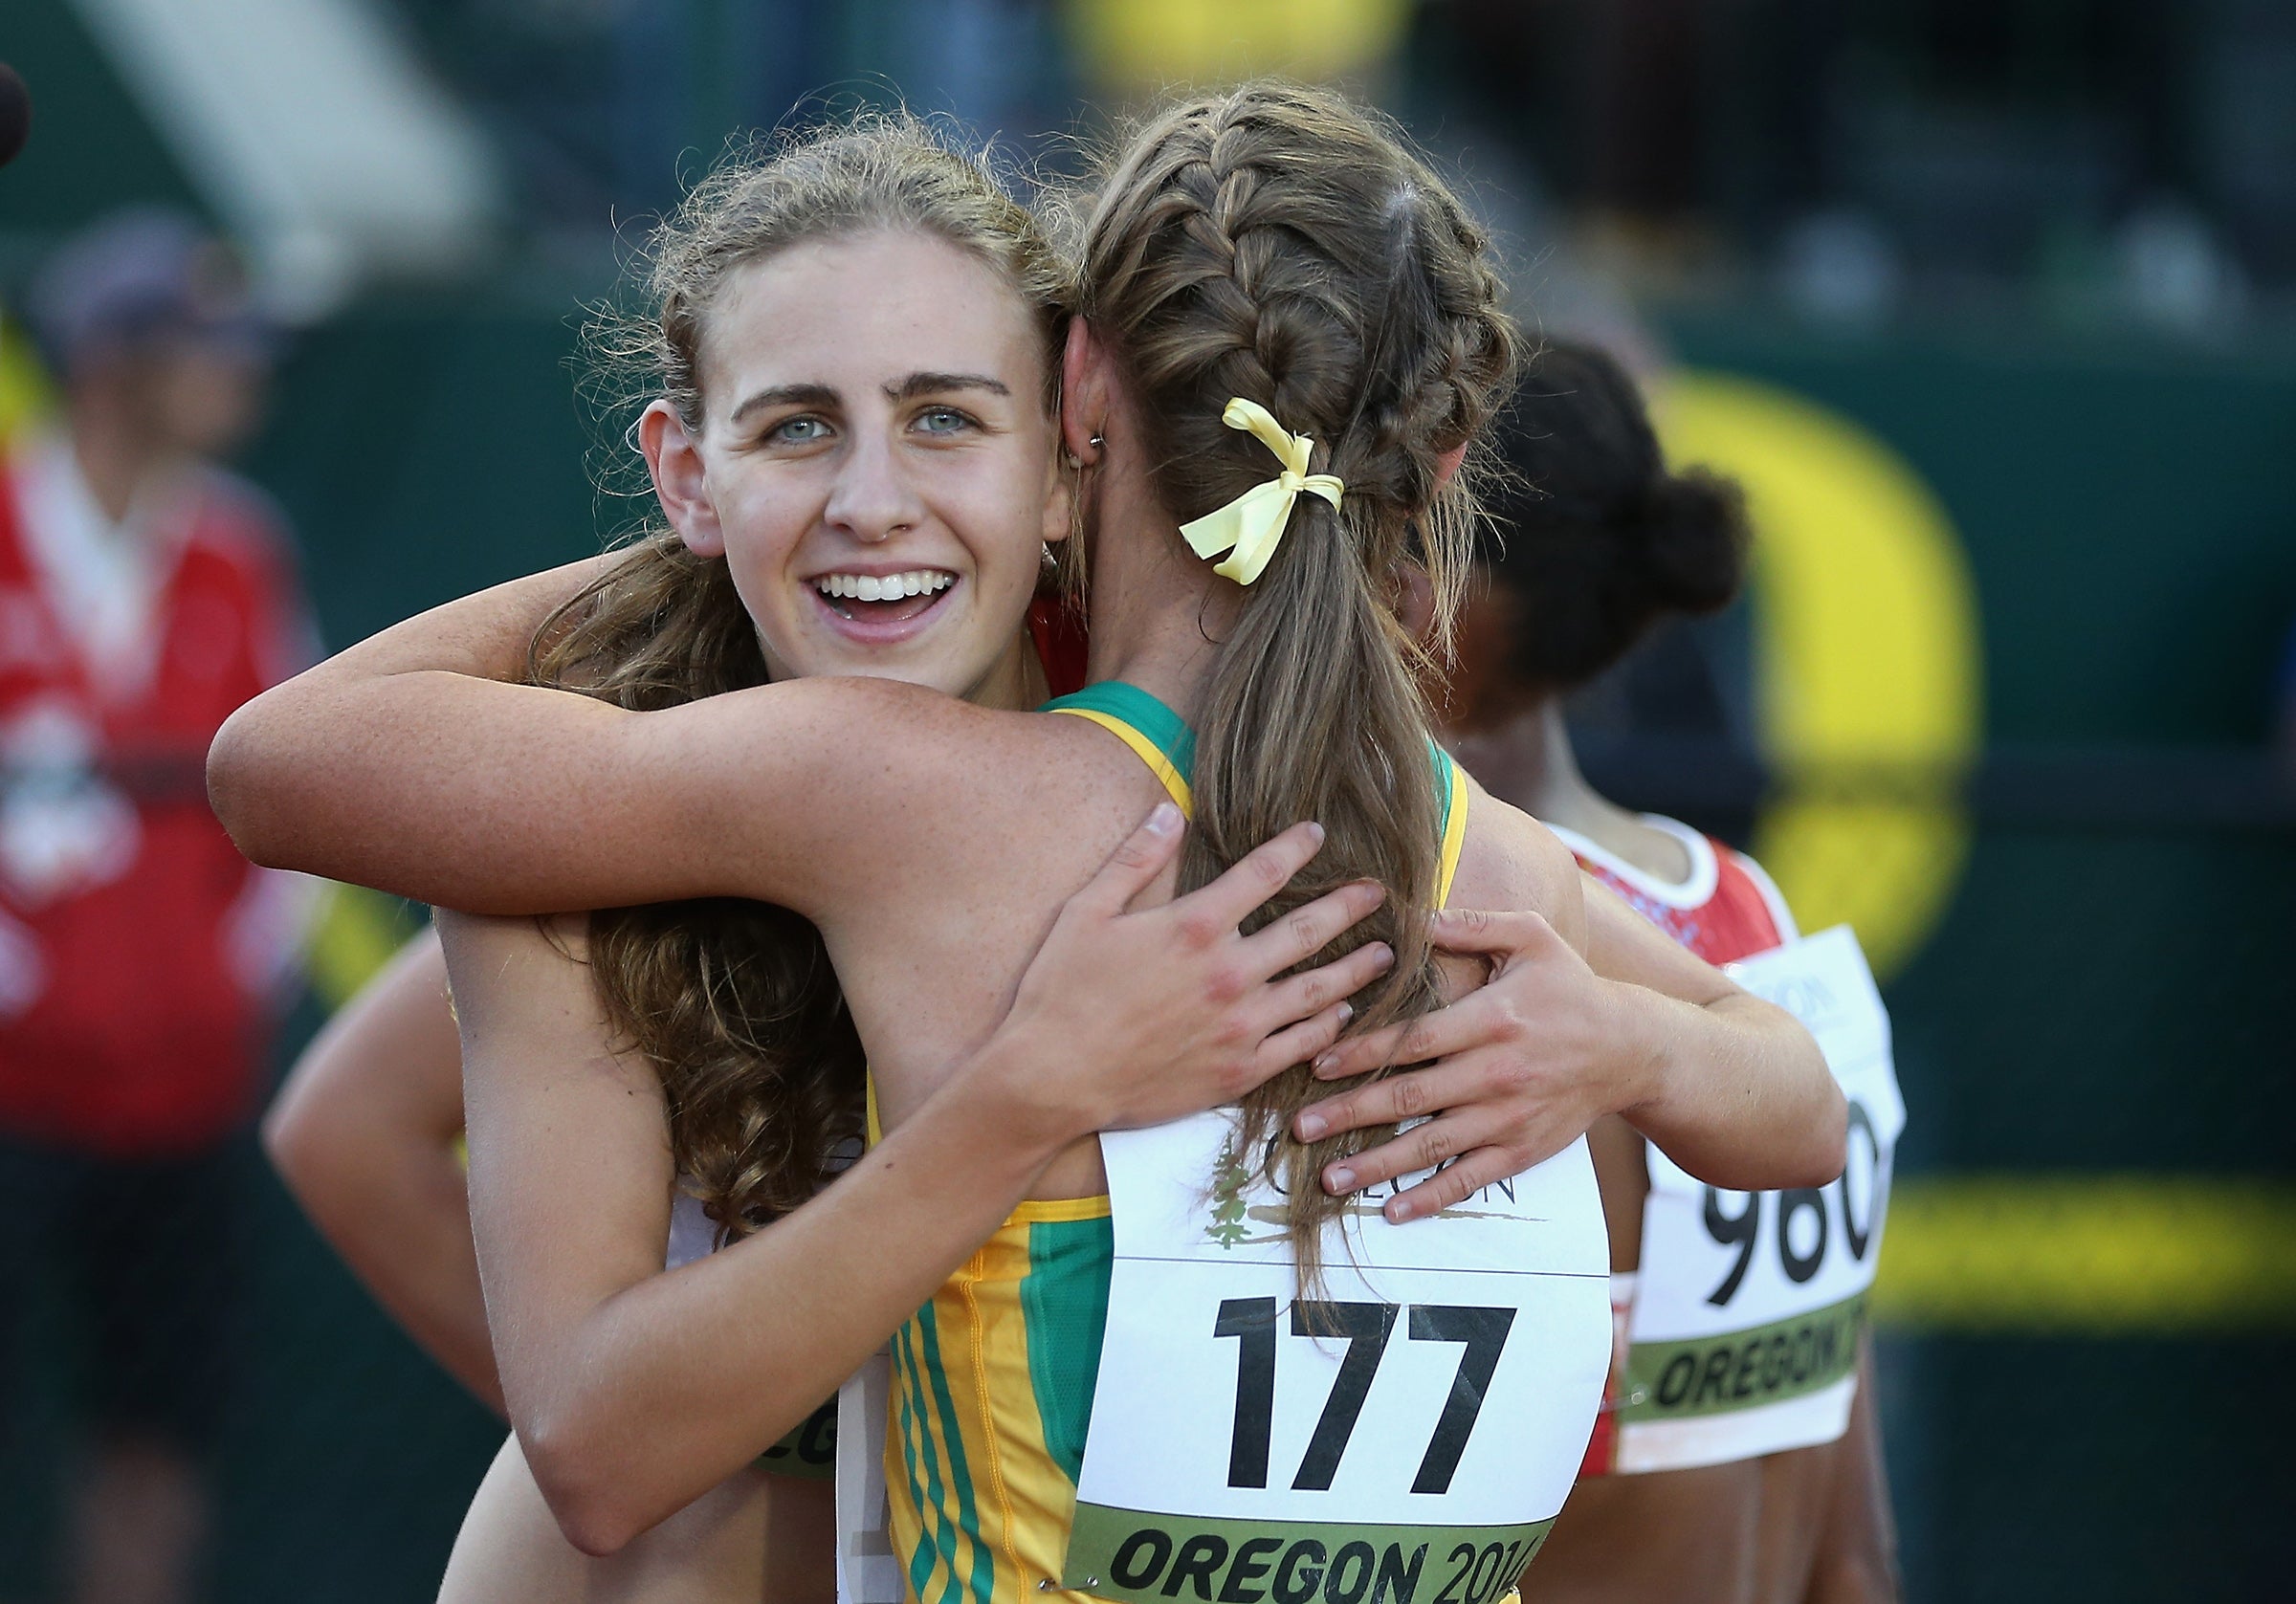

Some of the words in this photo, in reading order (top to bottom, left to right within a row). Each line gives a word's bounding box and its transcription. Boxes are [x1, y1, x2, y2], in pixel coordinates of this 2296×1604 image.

[1213, 1296, 1517, 1495] 177
[1657, 1317, 1838, 1409] OREGON
[1110, 1528, 1430, 1604] OREGON
